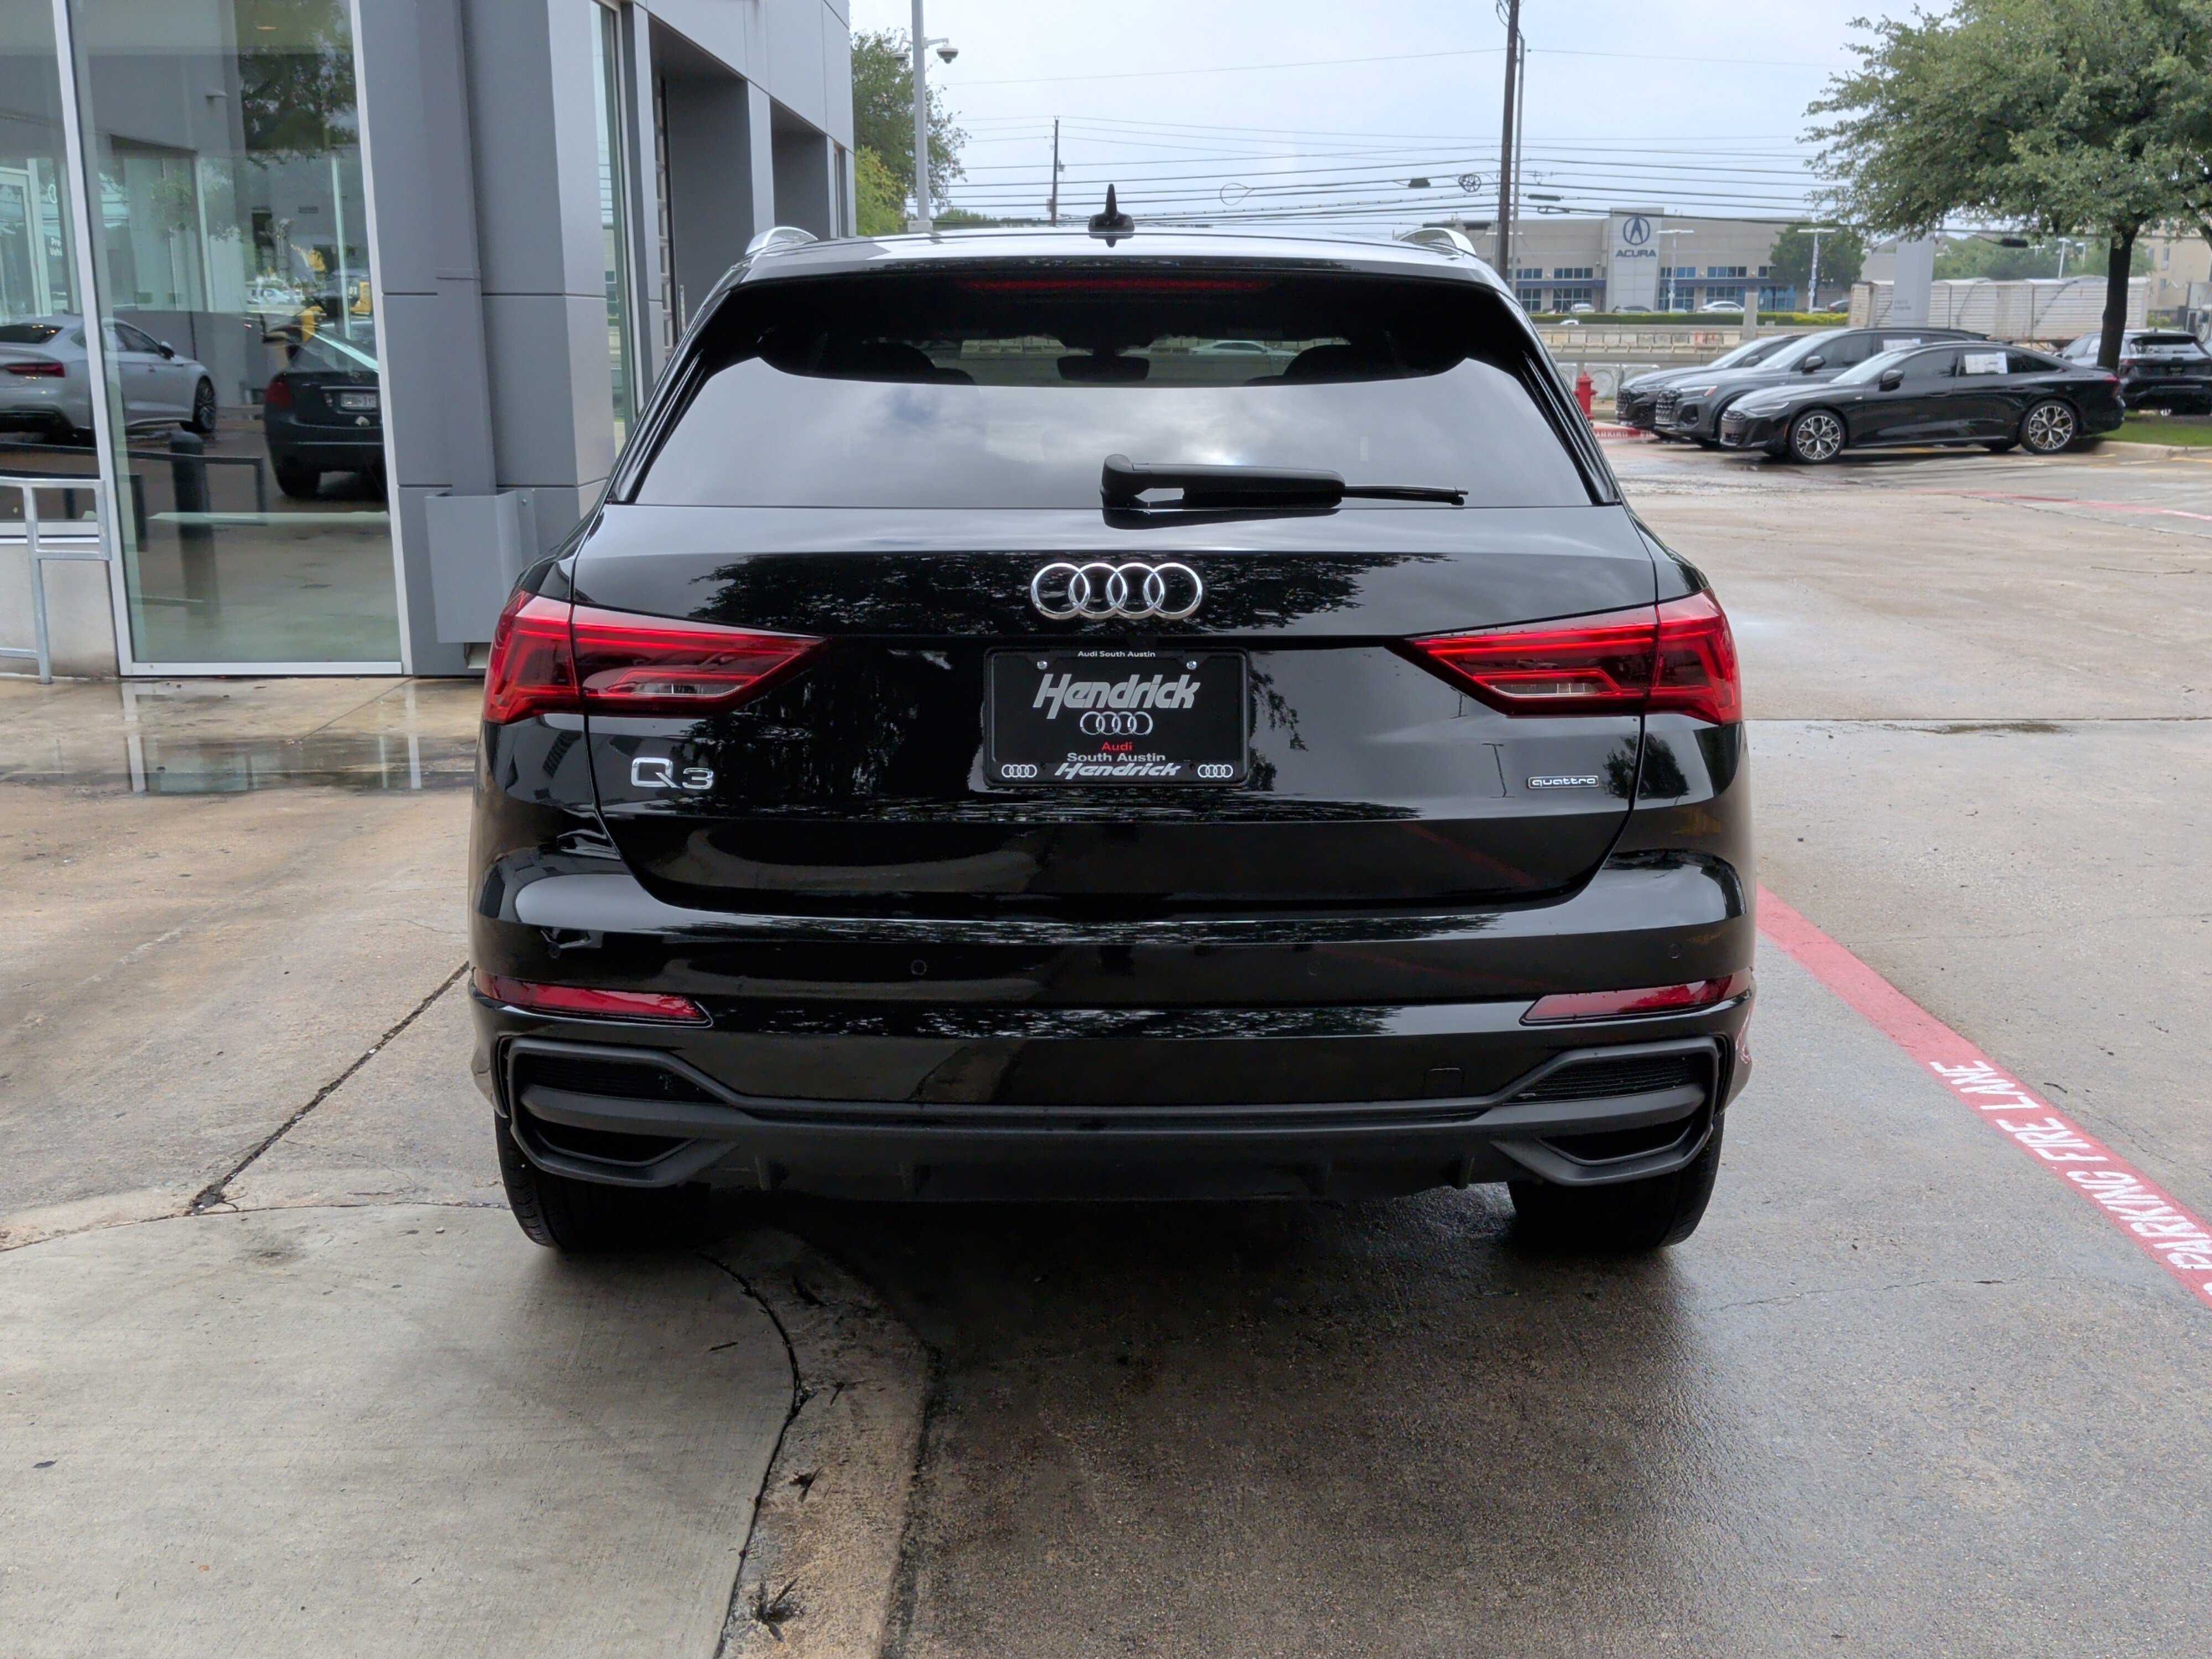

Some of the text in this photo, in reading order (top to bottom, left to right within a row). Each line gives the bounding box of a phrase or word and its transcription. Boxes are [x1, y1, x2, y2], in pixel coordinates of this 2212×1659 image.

[1032, 674, 1201, 719] Hendrick
[1067, 753, 1166, 762] South Austin
[1102, 742, 1133, 751] Audi
[631, 757, 714, 790] Q3
[1054, 763, 1181, 780] Hendrick
[1532, 778, 1595, 786] quattro
[1929, 1061, 2041, 1109] LANE
[1995, 1117, 2109, 1161] FIRE
